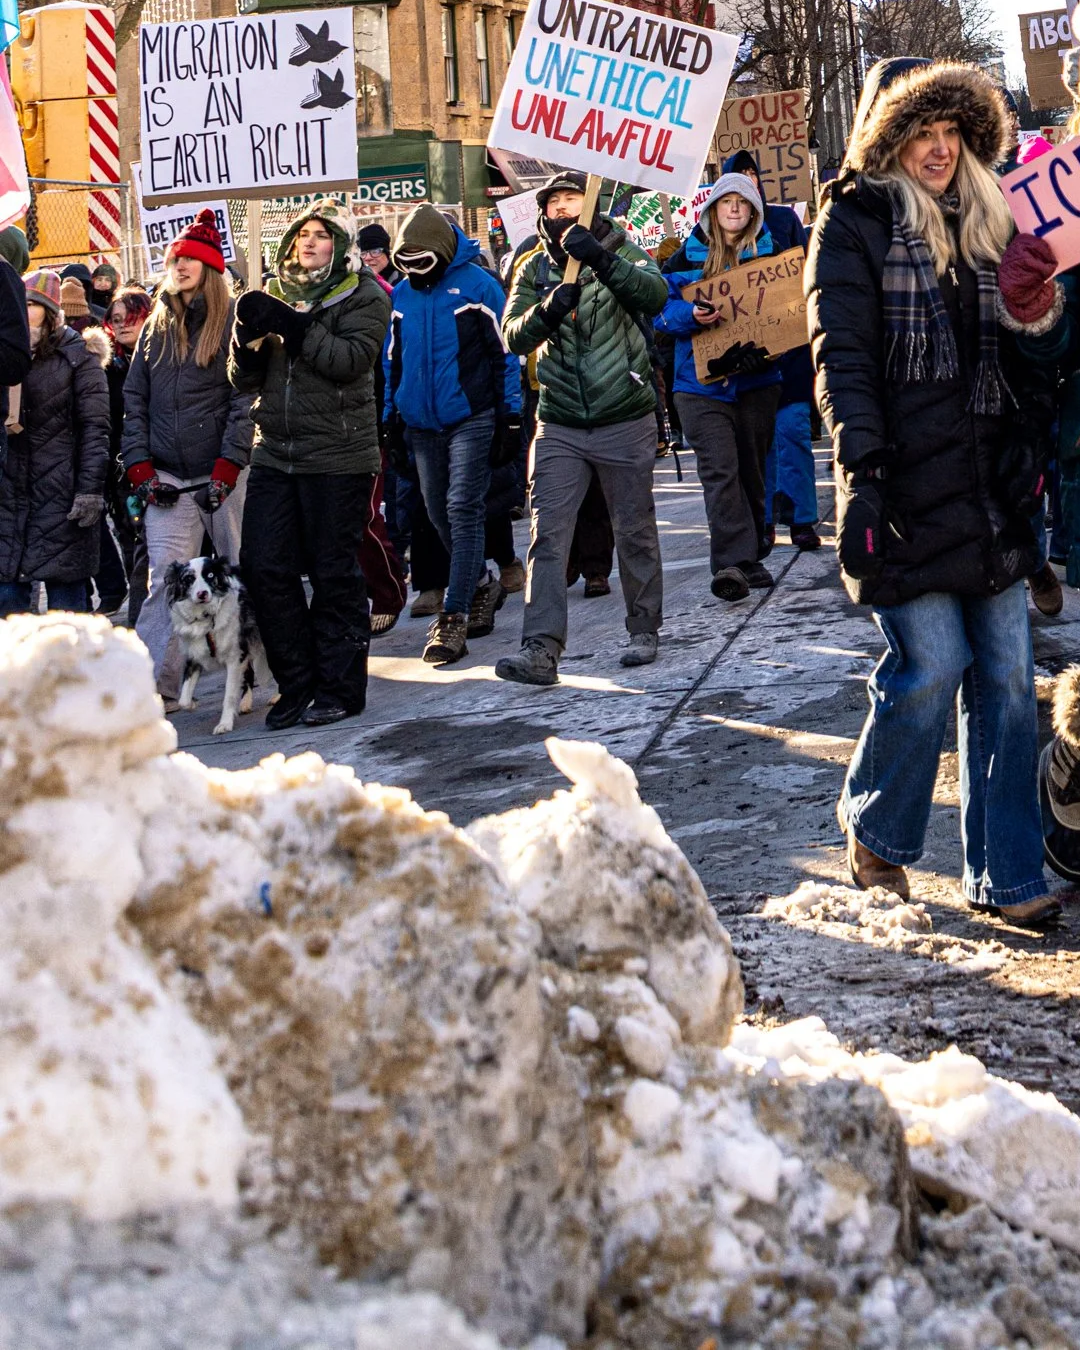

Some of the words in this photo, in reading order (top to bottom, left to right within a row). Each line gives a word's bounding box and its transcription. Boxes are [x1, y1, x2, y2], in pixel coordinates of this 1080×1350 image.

[141, 19, 278, 84] MIGRATION
[525, 37, 693, 130] UNETHICAL
[143, 86, 174, 132] IS
[203, 78, 243, 128] AN
[511, 89, 675, 173] UNLAWFUL
[149, 131, 231, 192] EARTH
[249, 117, 332, 182] RIGHT
[145, 221, 168, 245] ICE
[694, 280, 731, 303] NO
